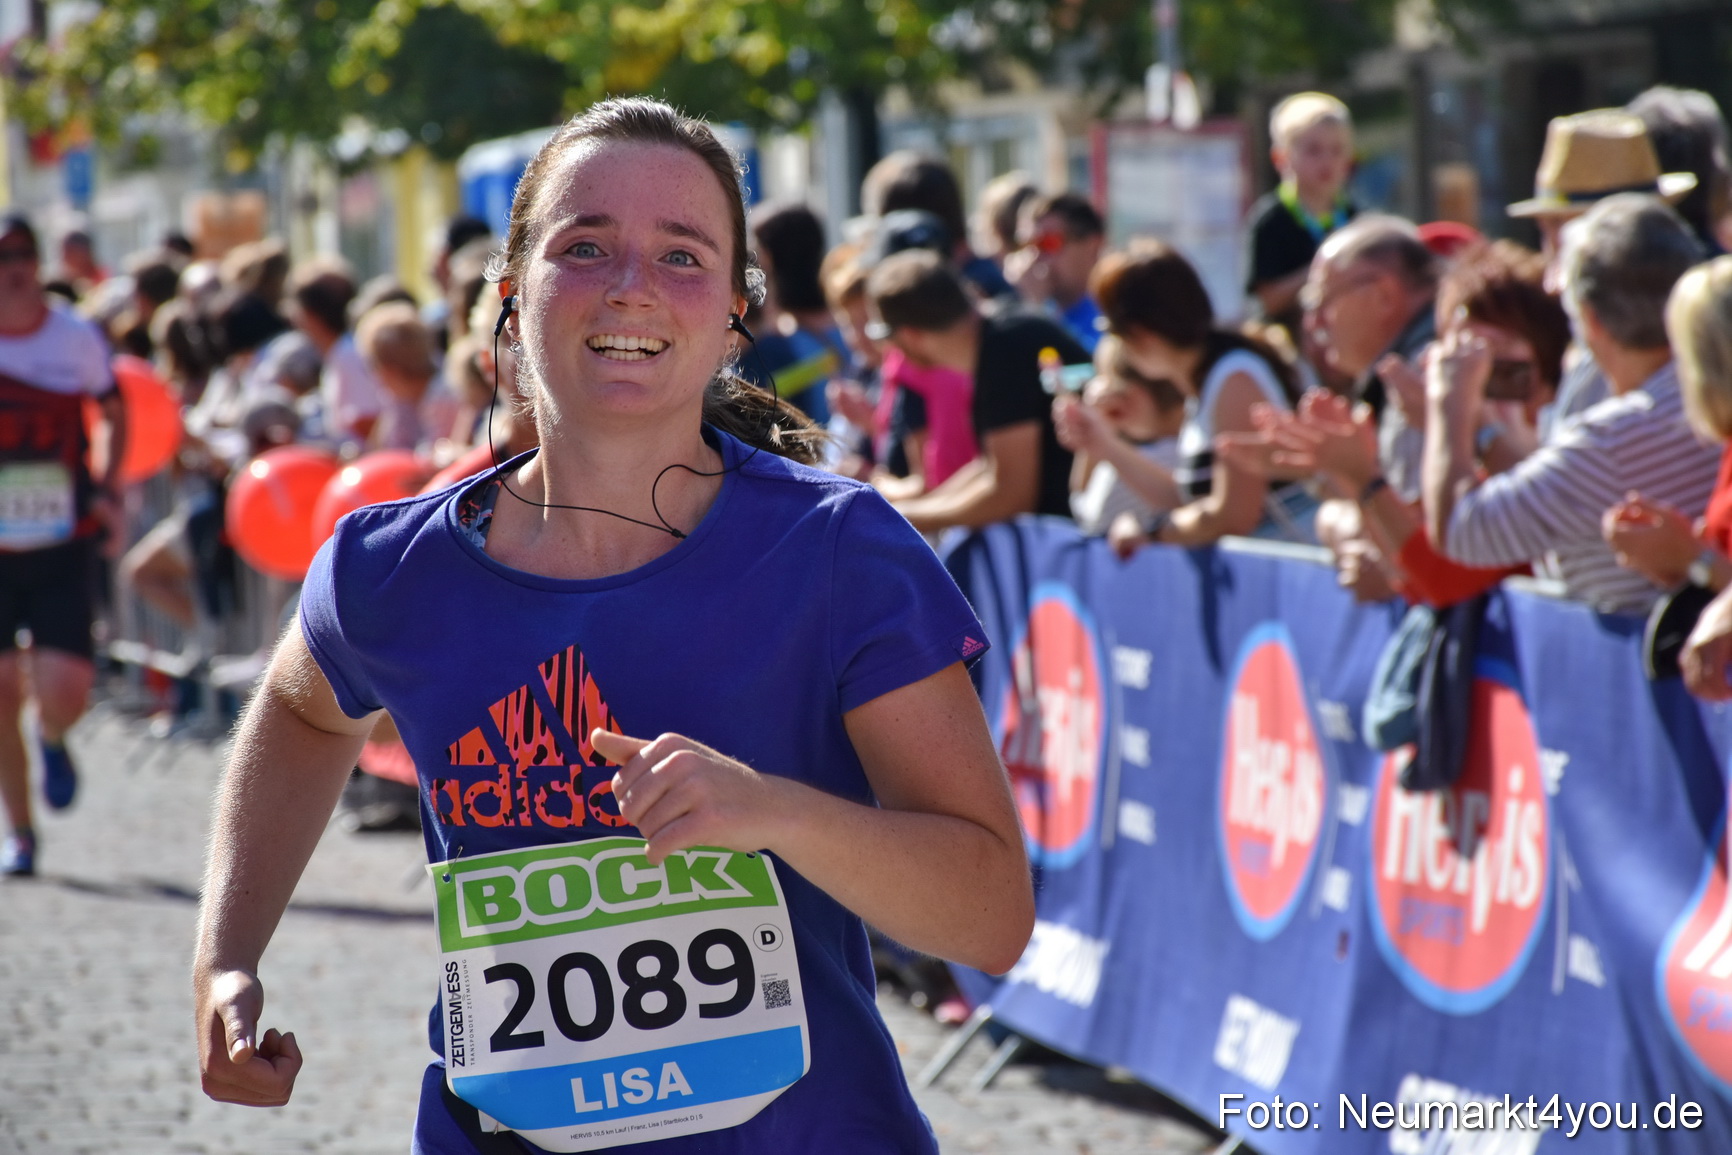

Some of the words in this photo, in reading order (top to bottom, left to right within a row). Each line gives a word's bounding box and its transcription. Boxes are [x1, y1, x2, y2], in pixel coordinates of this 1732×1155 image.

[962, 642, 985, 657] adidas
[456, 849, 750, 935] BOCK
[760, 930, 776, 946] D
[462, 959, 473, 1009] ZEITMESSUNG
[483, 928, 755, 1053] 2089
[570, 1061, 694, 1113] LISA
[570, 1131, 593, 1140] HERVIS
[615, 1126, 627, 1134] Lauf
[648, 1121, 660, 1129] Lisa
[663, 1116, 689, 1126] Startblock
